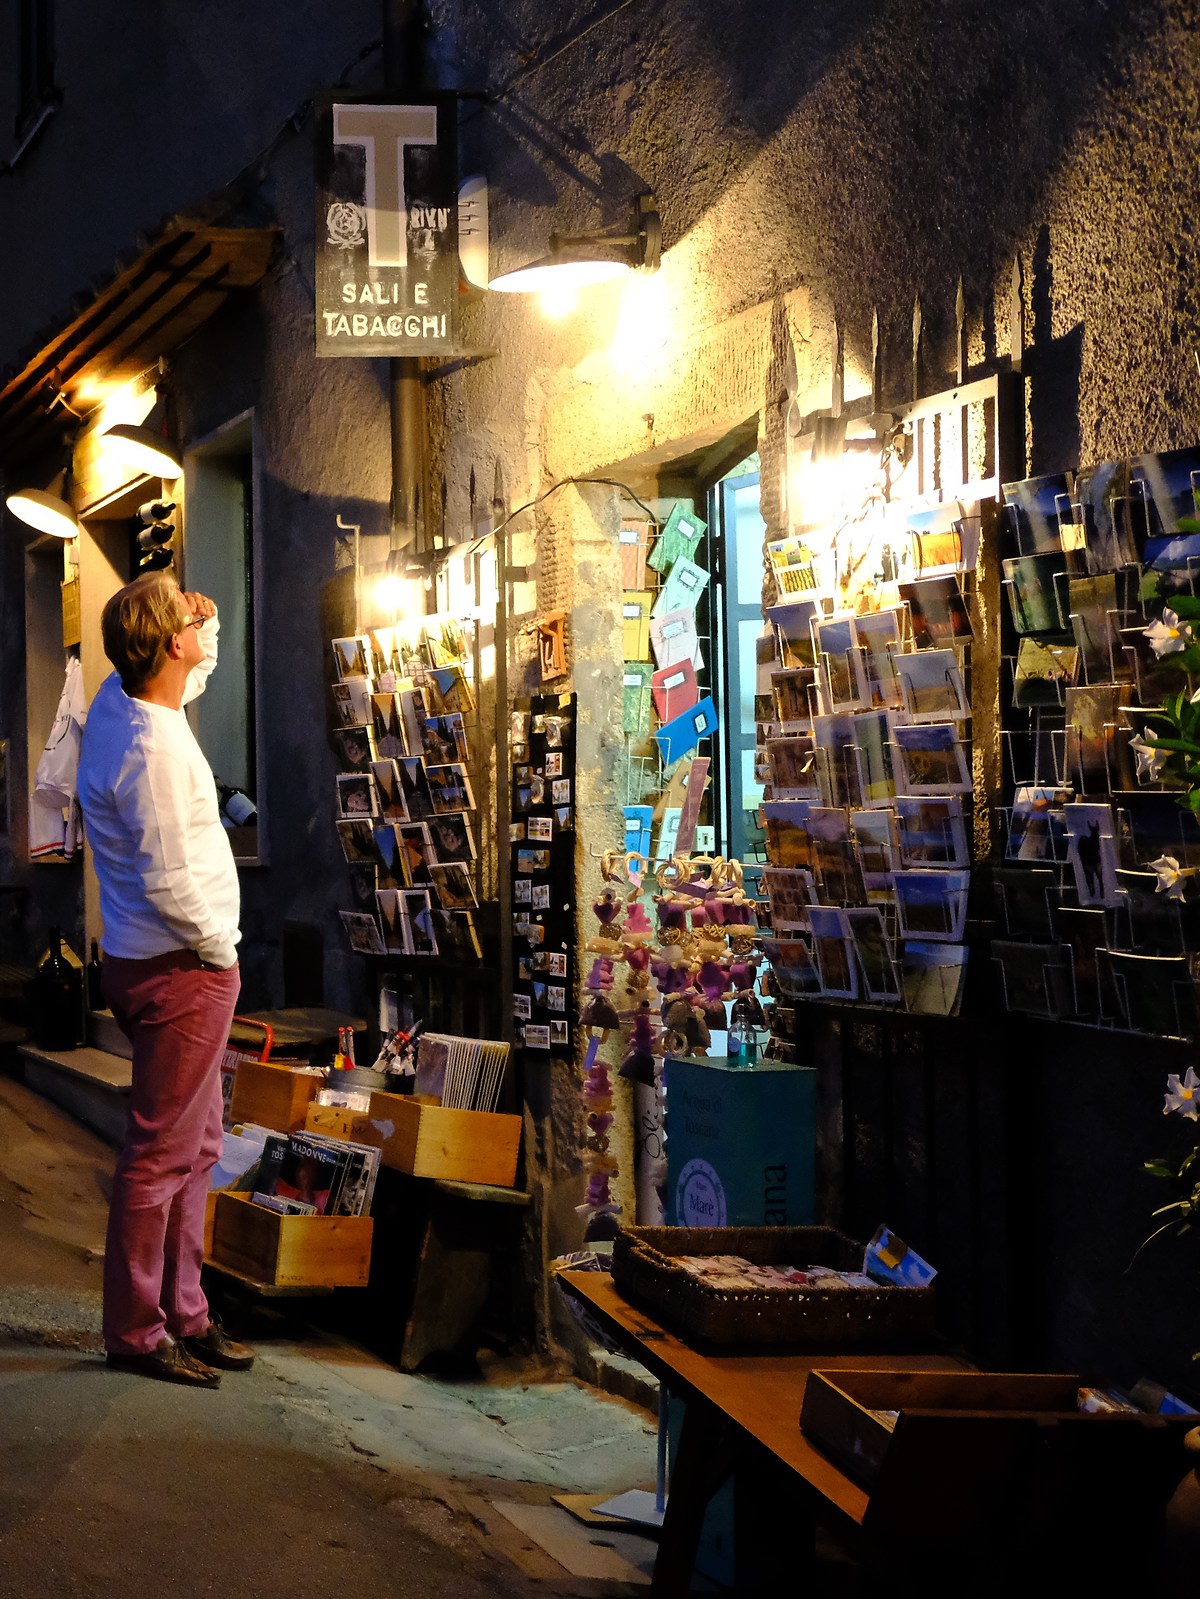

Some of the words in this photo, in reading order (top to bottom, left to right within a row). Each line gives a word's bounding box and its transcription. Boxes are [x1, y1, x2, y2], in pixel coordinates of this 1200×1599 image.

[333, 103, 437, 266] T
[342, 283, 398, 304] SALI
[414, 283, 428, 303] E
[322, 311, 447, 338] TABACCHI
[291, 1141, 326, 1163] MADONNE
